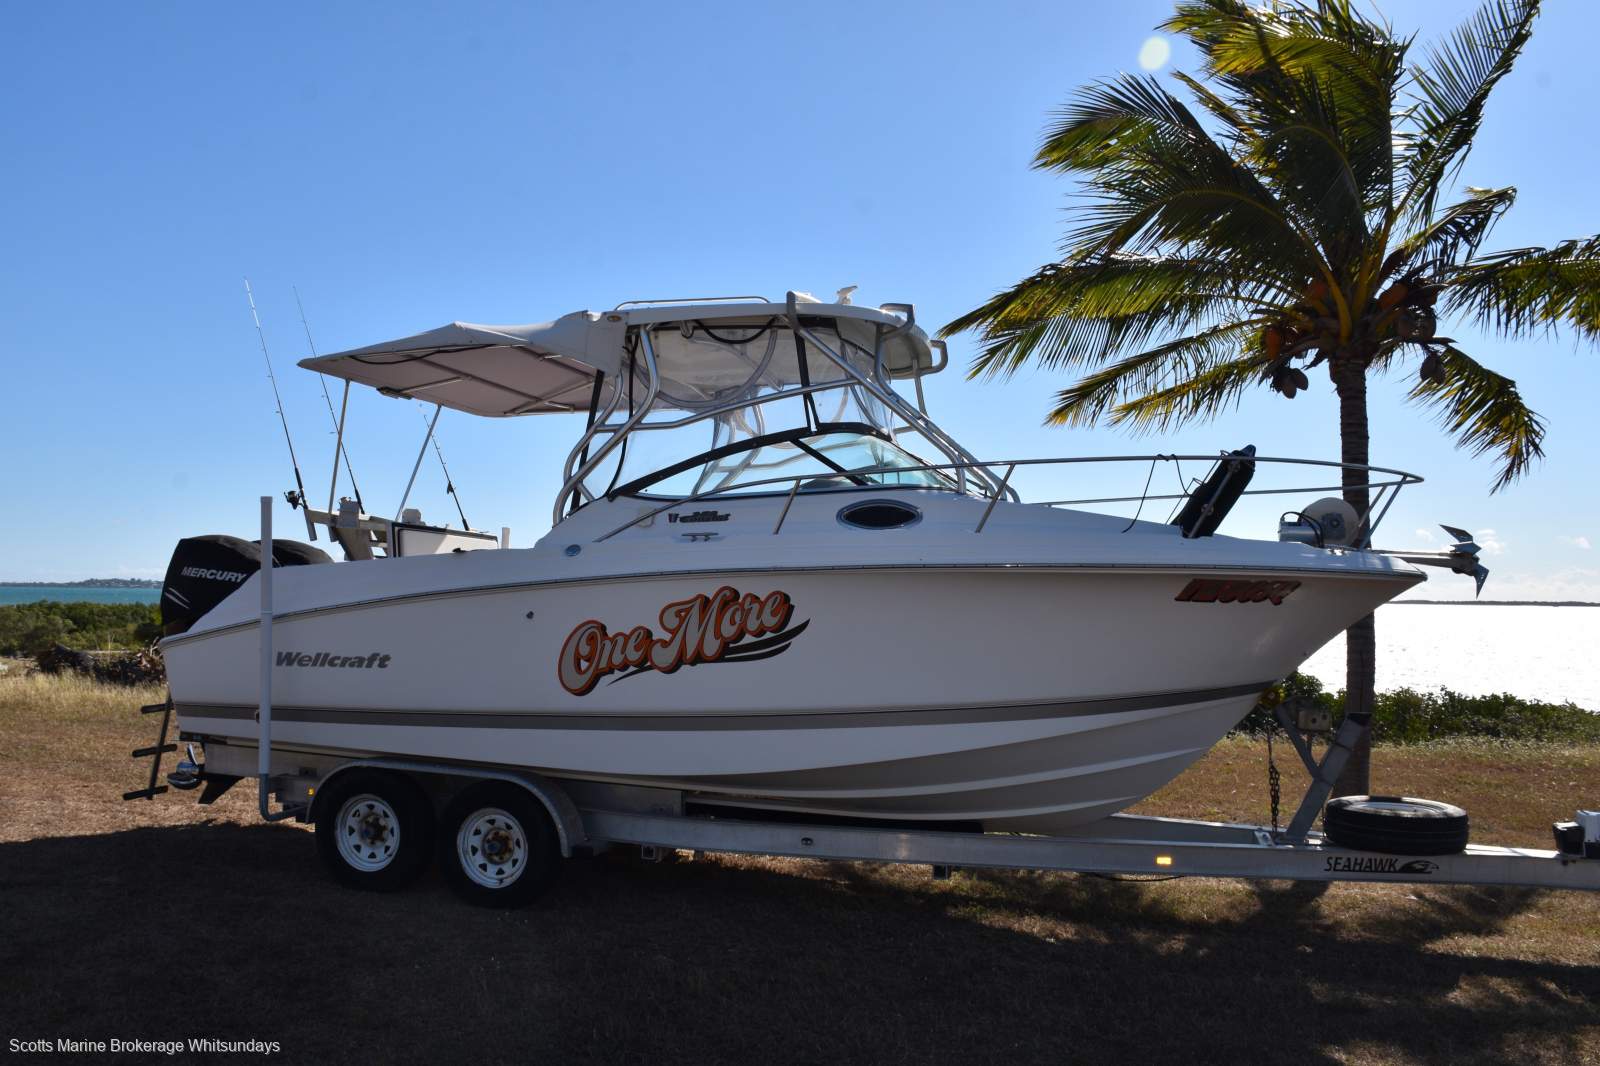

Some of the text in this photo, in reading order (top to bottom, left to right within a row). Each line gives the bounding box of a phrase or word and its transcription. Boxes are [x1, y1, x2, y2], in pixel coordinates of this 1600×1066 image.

[181, 566, 247, 583] MERCURY
[558, 585, 794, 696] One More
[275, 651, 392, 669] Wellcraft
[1324, 857, 1399, 873] SEAHAWK
